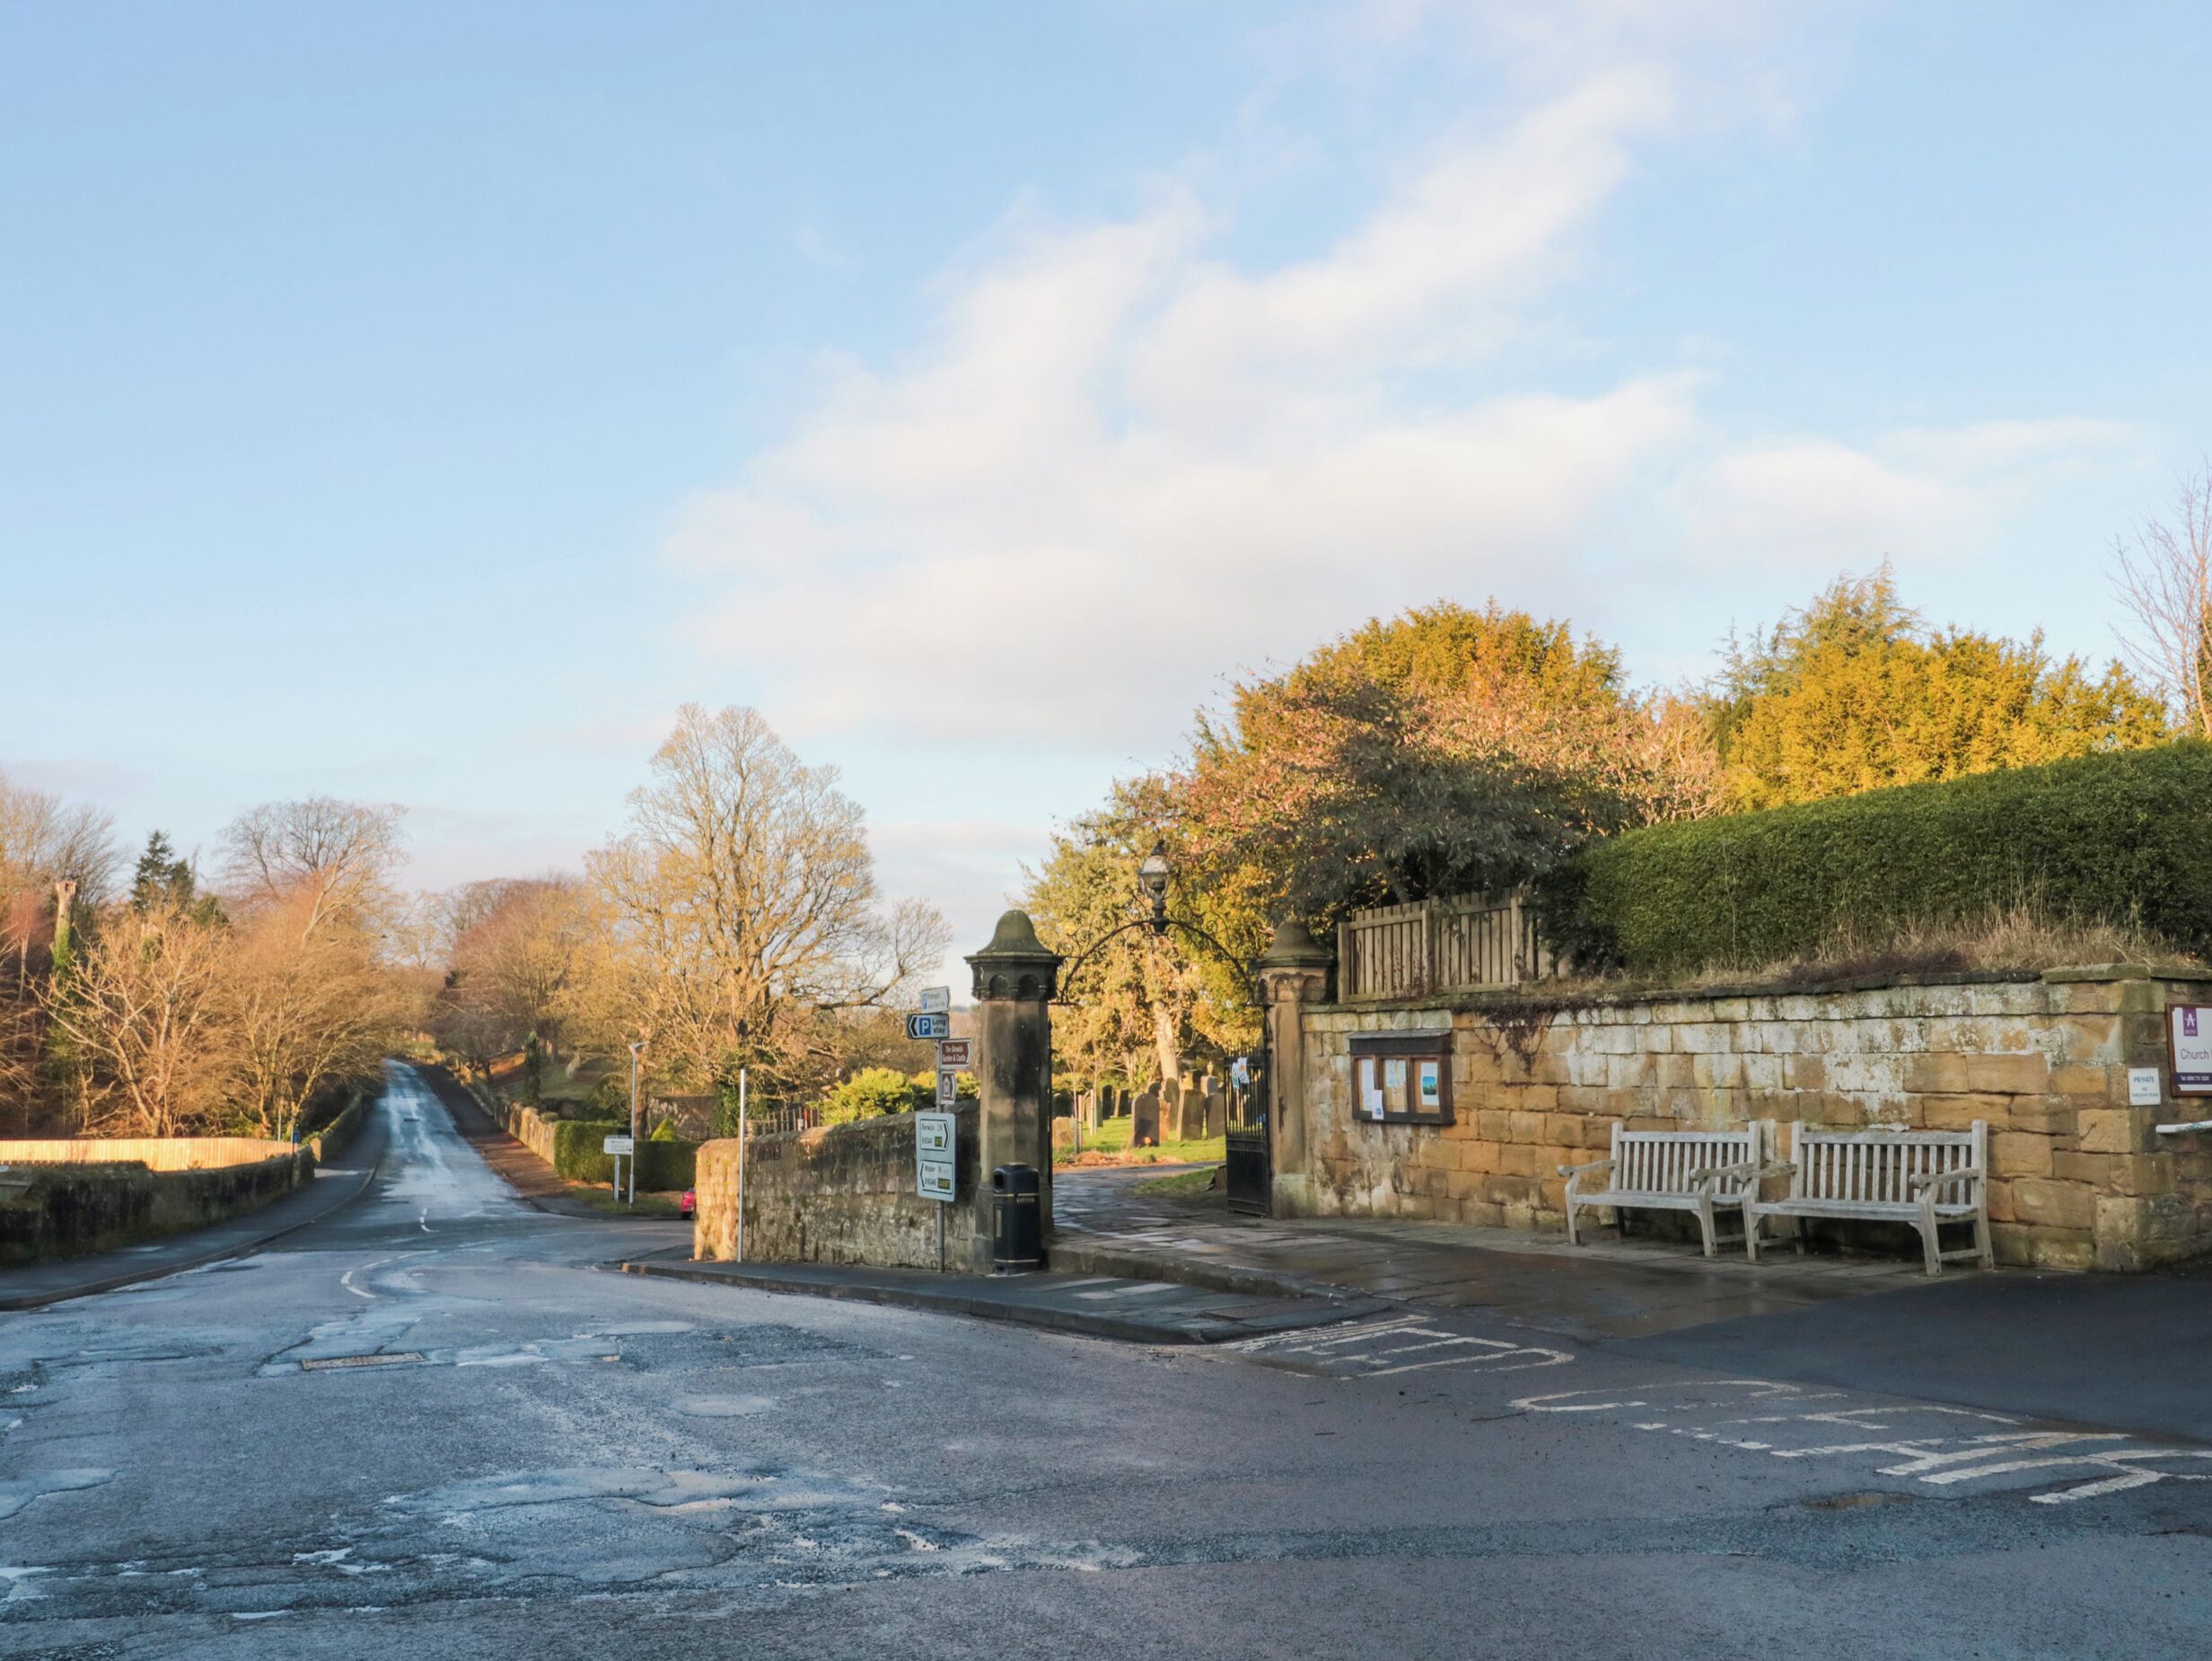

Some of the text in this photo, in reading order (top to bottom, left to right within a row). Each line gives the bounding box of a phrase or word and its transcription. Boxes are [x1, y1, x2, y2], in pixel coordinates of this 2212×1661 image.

[932, 1017, 946, 1026] Long
[921, 1019, 930, 1034] P
[933, 1026, 945, 1034] stay
[2181, 1048, 2209, 1059] Church
[922, 1123, 935, 1131] Berwick
